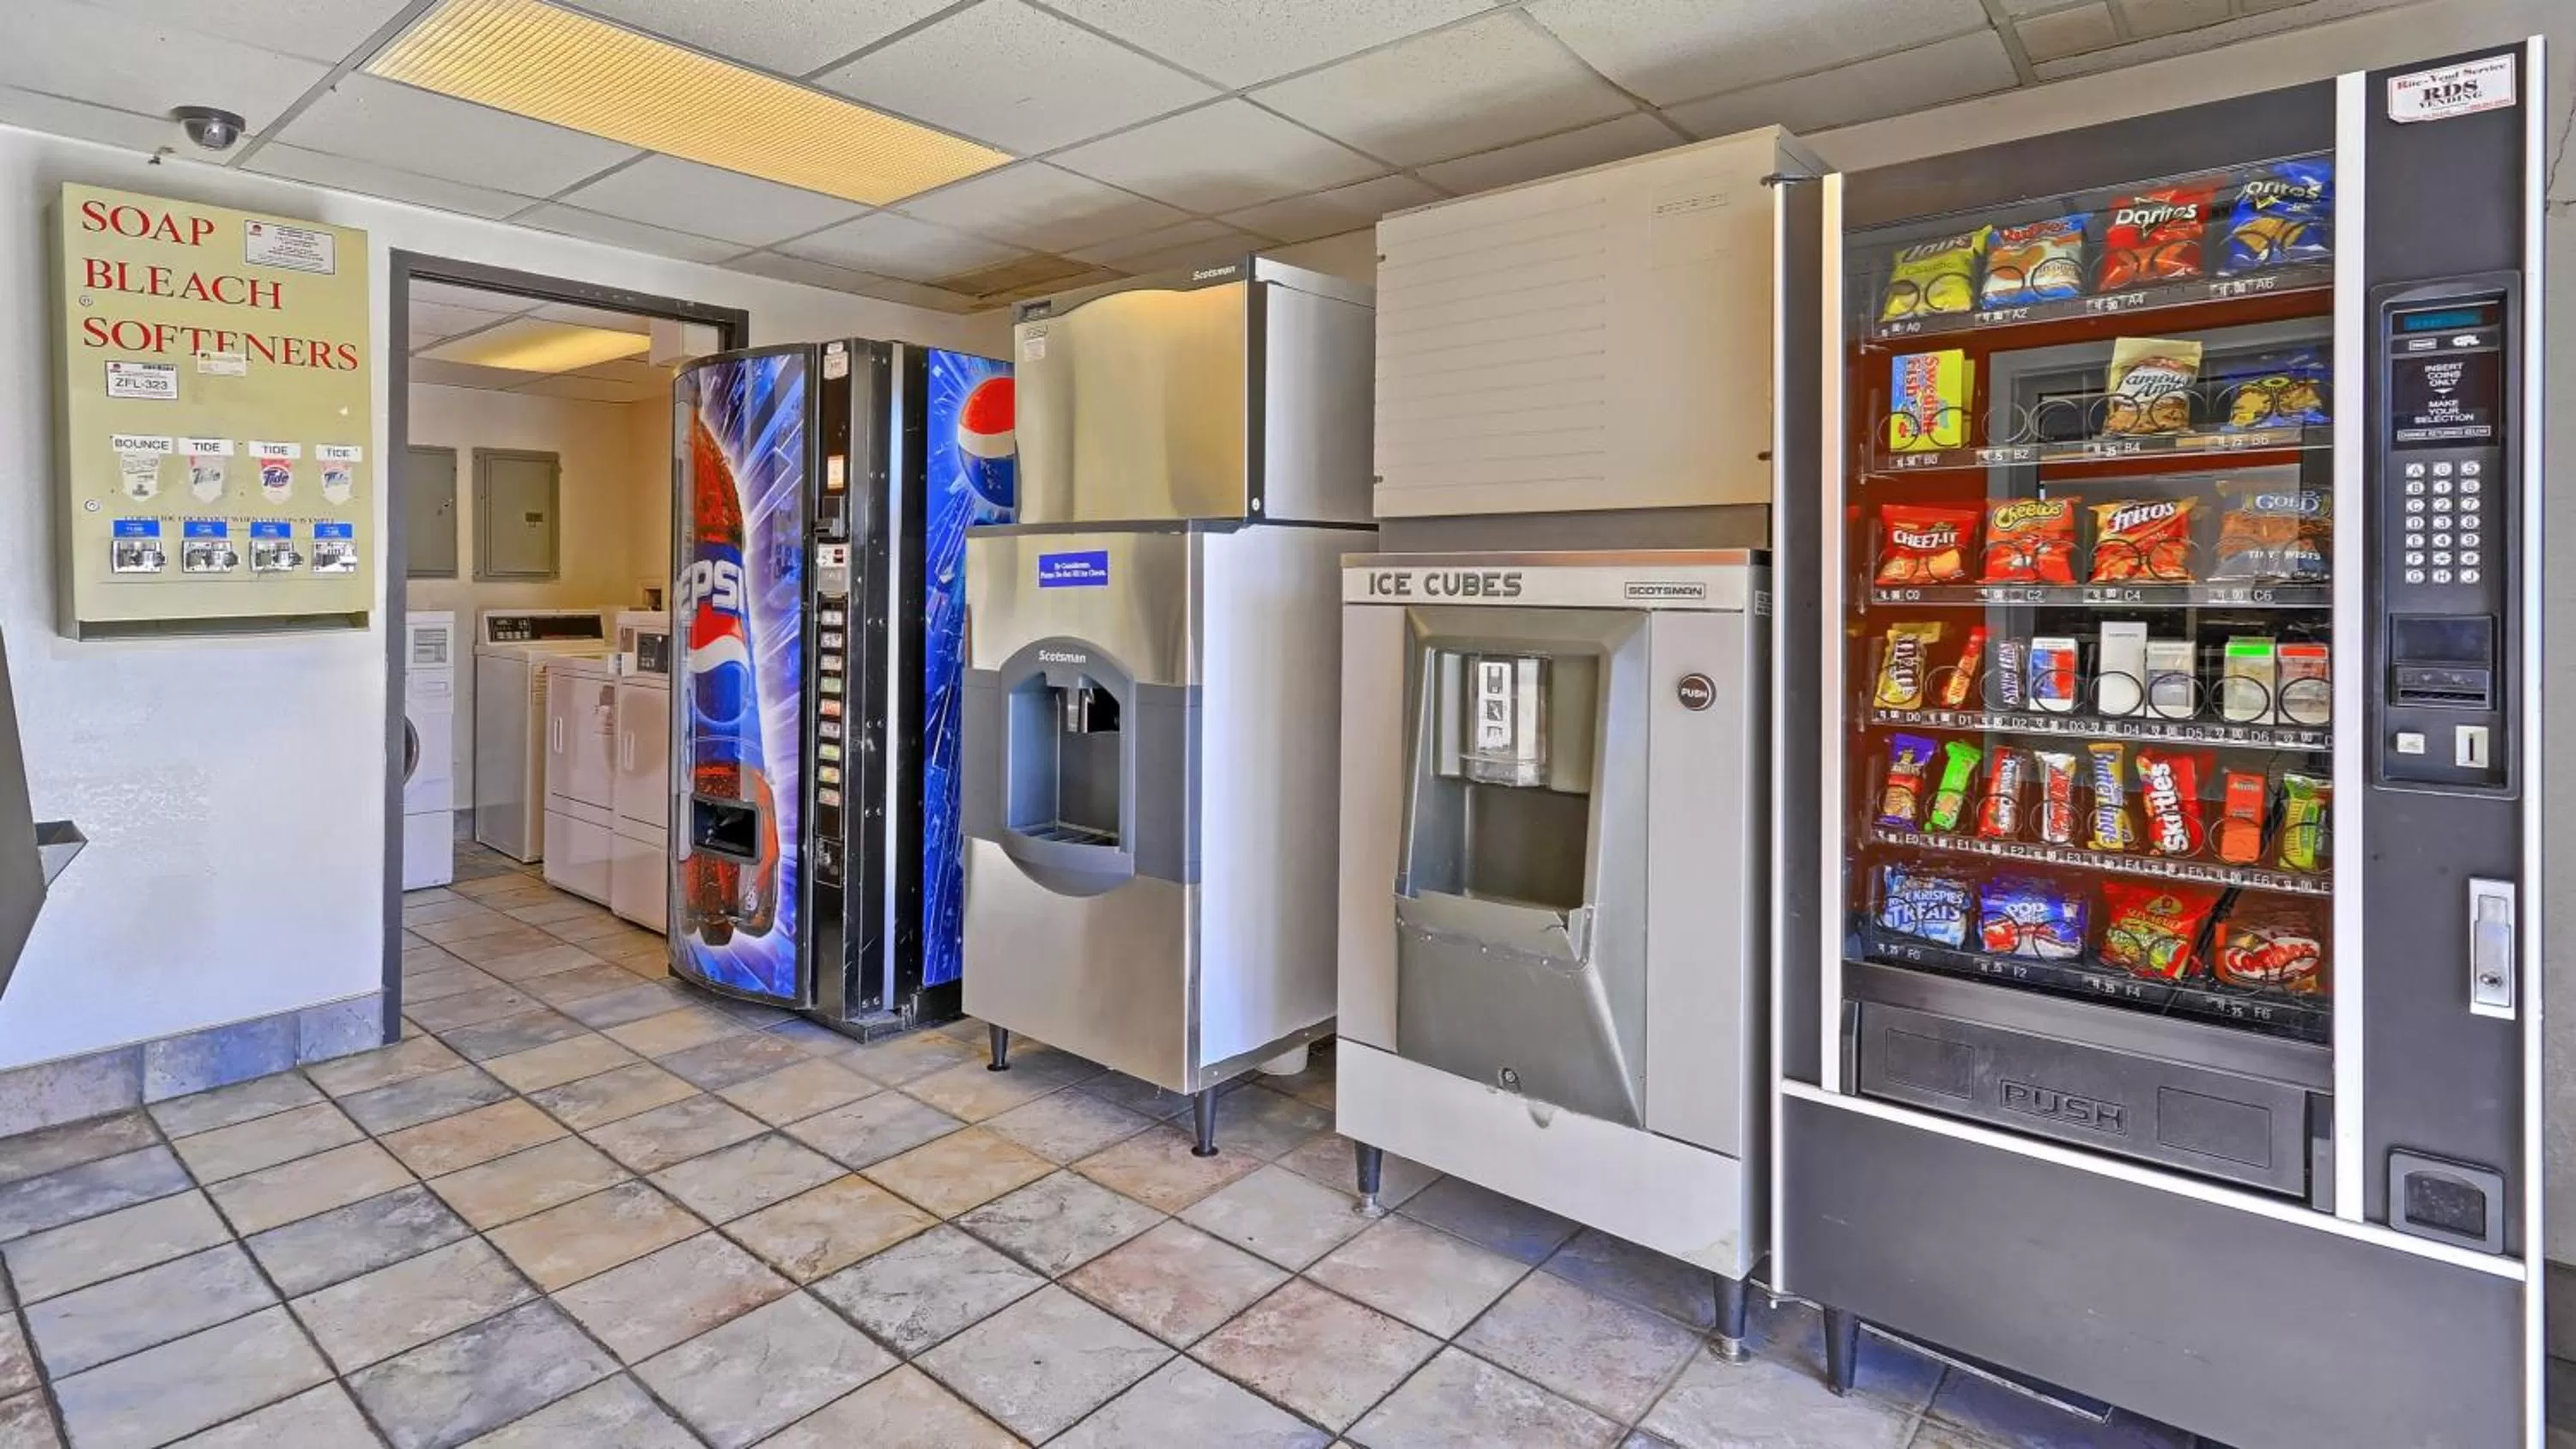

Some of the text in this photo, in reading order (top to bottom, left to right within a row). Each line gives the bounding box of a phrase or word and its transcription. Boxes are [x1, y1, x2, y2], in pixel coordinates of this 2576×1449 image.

[2424, 80, 2478, 100] RDS
[2116, 203, 2198, 227] Doritos
[82, 200, 215, 246] SOAP
[1193, 264, 1236, 281] Scotsman
[82, 258, 283, 310] BLEACH
[83, 317, 358, 371] SOFTENERS
[2425, 362, 2463, 372] INSERT
[115, 378, 168, 391] ZFL-323
[1923, 356, 1941, 434] Swedish
[2415, 413, 2474, 424] SELECTION
[114, 438, 169, 451] BOUNCE
[192, 441, 221, 452] TIDE
[263, 445, 289, 456] TIDE
[326, 447, 350, 458] TIDE
[263, 469, 289, 487] Tide
[2255, 494, 2320, 513] GOLD
[1994, 501, 2062, 527] Cheetos
[677, 559, 744, 611] EPSI
[1370, 573, 1522, 597] ICE CUBES
[1628, 586, 1703, 597] SCOTSMAN
[2125, 590, 2141, 601] C4
[2254, 591, 2273, 601] C6
[1039, 650, 1086, 664] Scotsman
[1680, 688, 1708, 699] PUSH
[1959, 715, 1972, 724] D1
[2013, 718, 2026, 728] D2
[2070, 721, 2085, 731] D3
[2123, 724, 2139, 736] D4
[2186, 727, 2202, 738] D5
[2251, 731, 2269, 742] D6
[2151, 762, 2189, 852] Skittles
[1957, 840, 1969, 850] E1
[2005, 1083, 2122, 1131] PUSH
